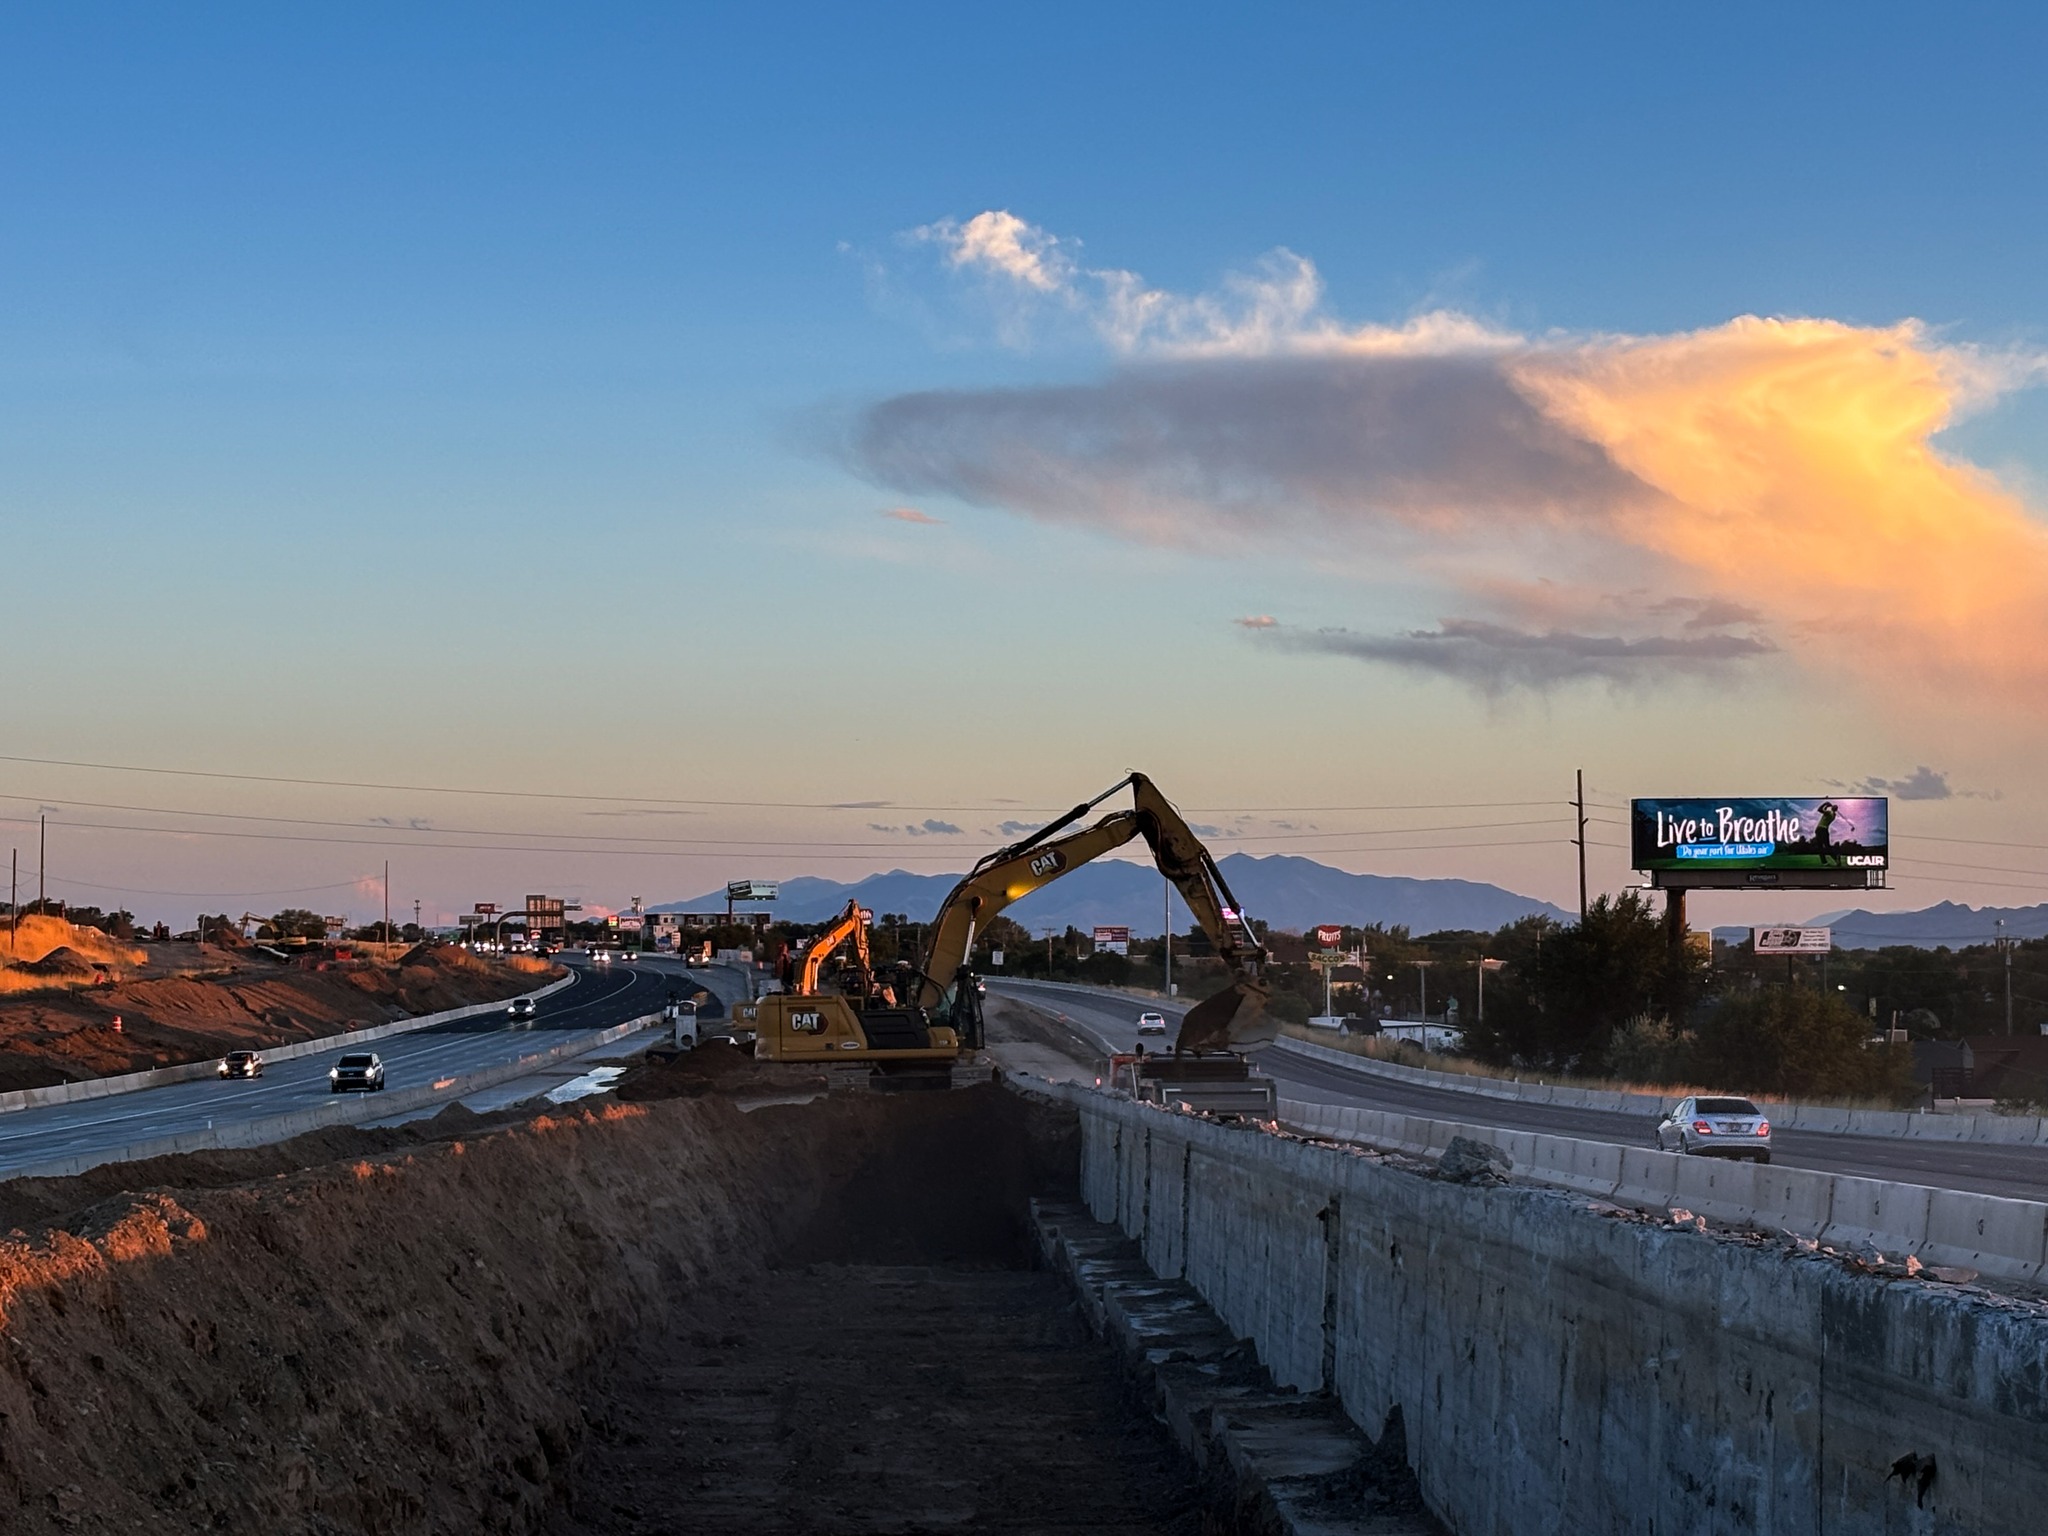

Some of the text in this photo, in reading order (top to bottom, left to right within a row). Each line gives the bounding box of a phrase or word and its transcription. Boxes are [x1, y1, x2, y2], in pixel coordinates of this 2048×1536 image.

[1656, 807, 1800, 848] Live to Breathe
[1681, 845, 1692, 857] Do
[1693, 848, 1708, 858] your
[1709, 846, 1723, 857] part
[1724, 845, 1735, 856] for
[1757, 846, 1769, 855] air
[1847, 855, 1885, 867] UCAIR
[1030, 851, 1059, 877] CAT
[791, 1013, 820, 1032] CAT
